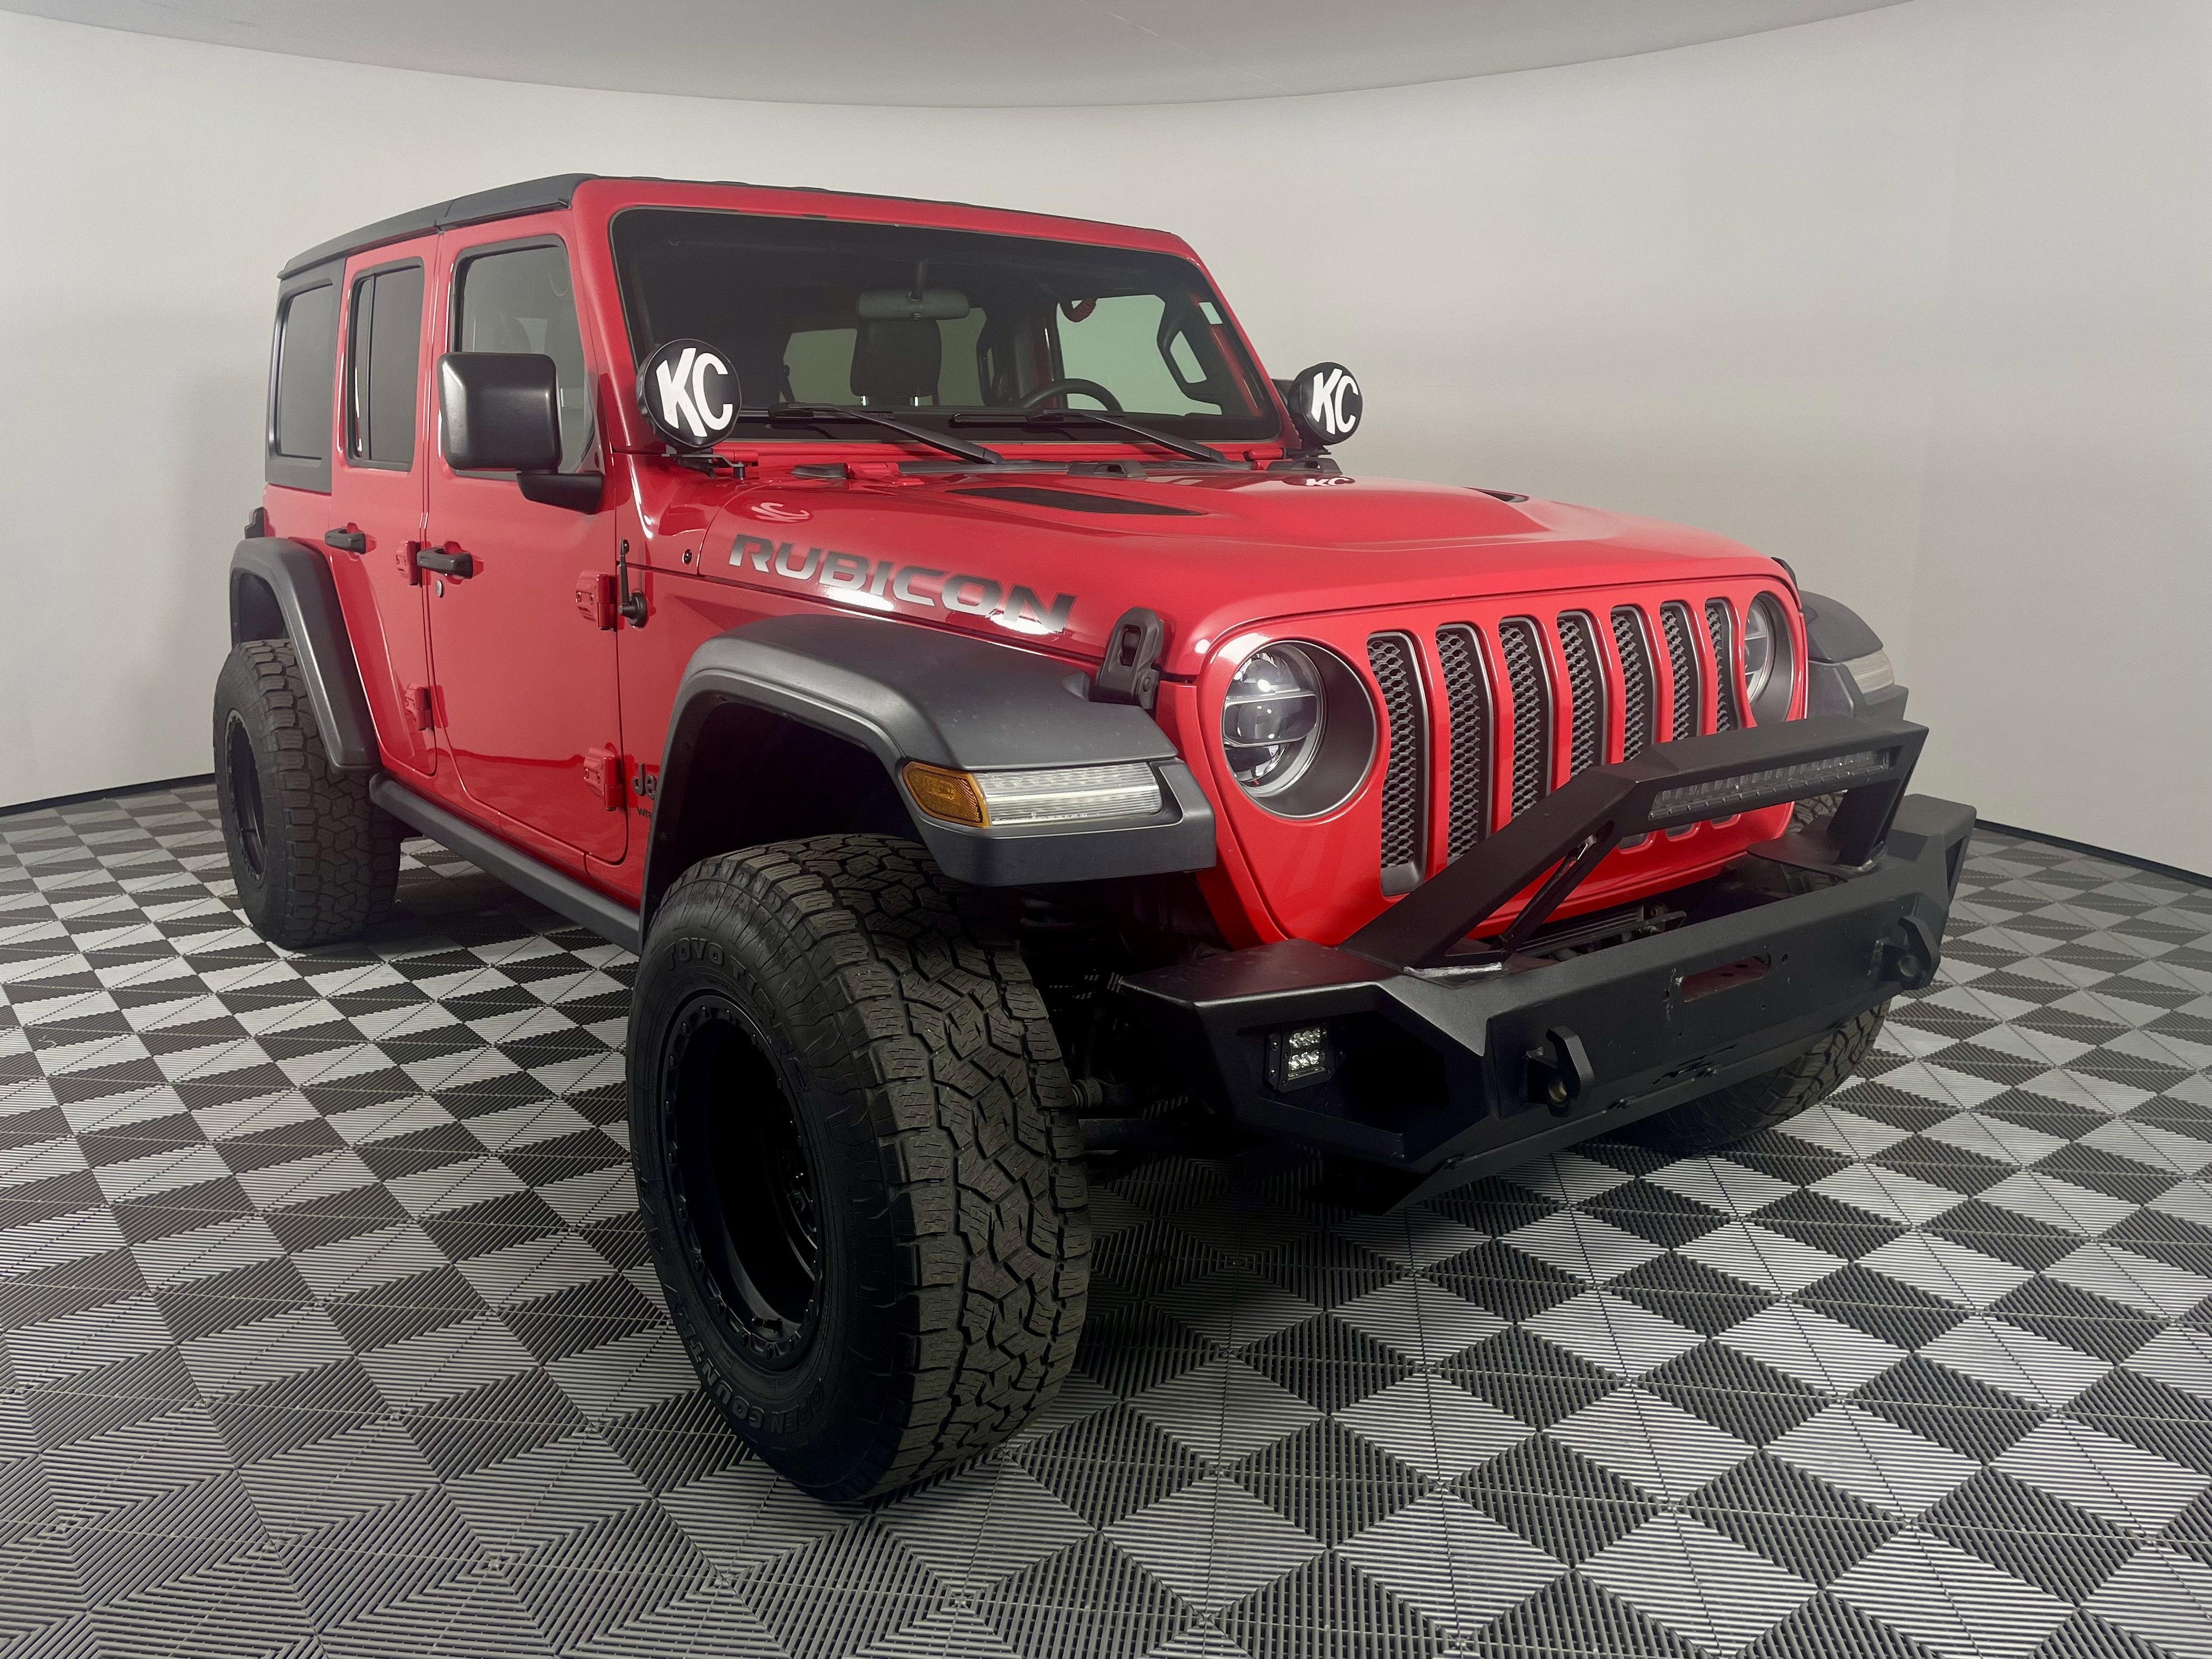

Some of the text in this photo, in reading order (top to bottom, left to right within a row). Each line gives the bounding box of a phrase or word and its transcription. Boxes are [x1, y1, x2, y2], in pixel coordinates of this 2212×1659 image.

[656, 347, 733, 437] KC
[1311, 368, 1359, 435] KC
[729, 534, 1079, 633] RUBICON
[632, 763, 658, 800] Je
[663, 937, 725, 970] TOYO
